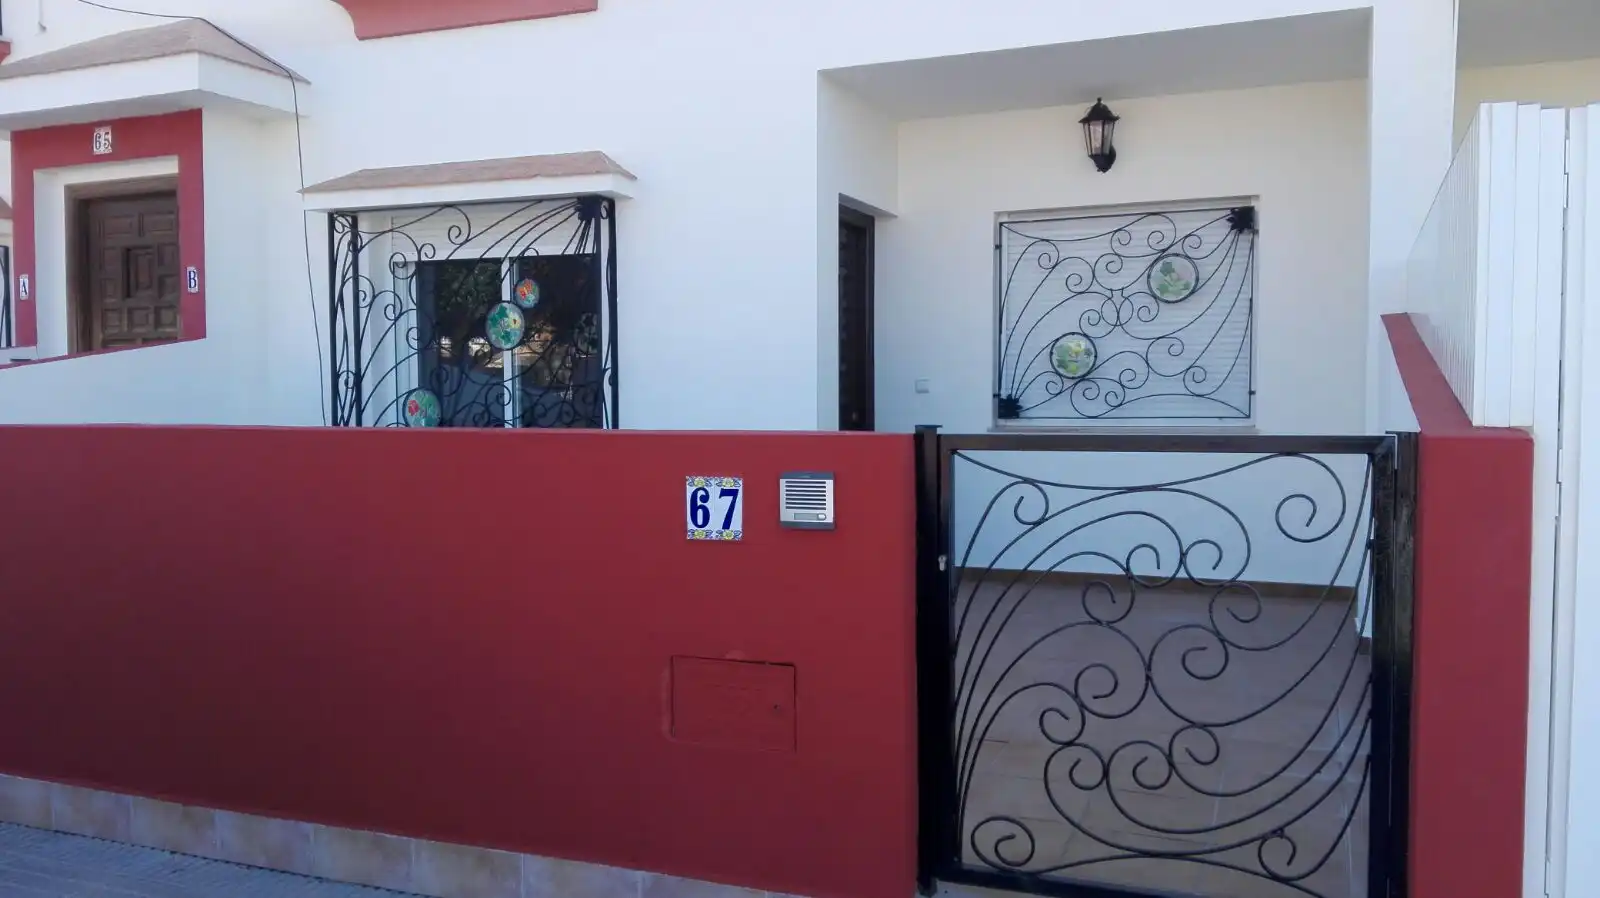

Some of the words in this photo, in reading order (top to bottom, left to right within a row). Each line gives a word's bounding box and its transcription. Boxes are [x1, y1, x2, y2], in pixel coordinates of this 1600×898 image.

[95, 131, 110, 150] 65
[21, 279, 28, 296] A
[188, 270, 197, 289] B
[689, 487, 739, 530] 67
